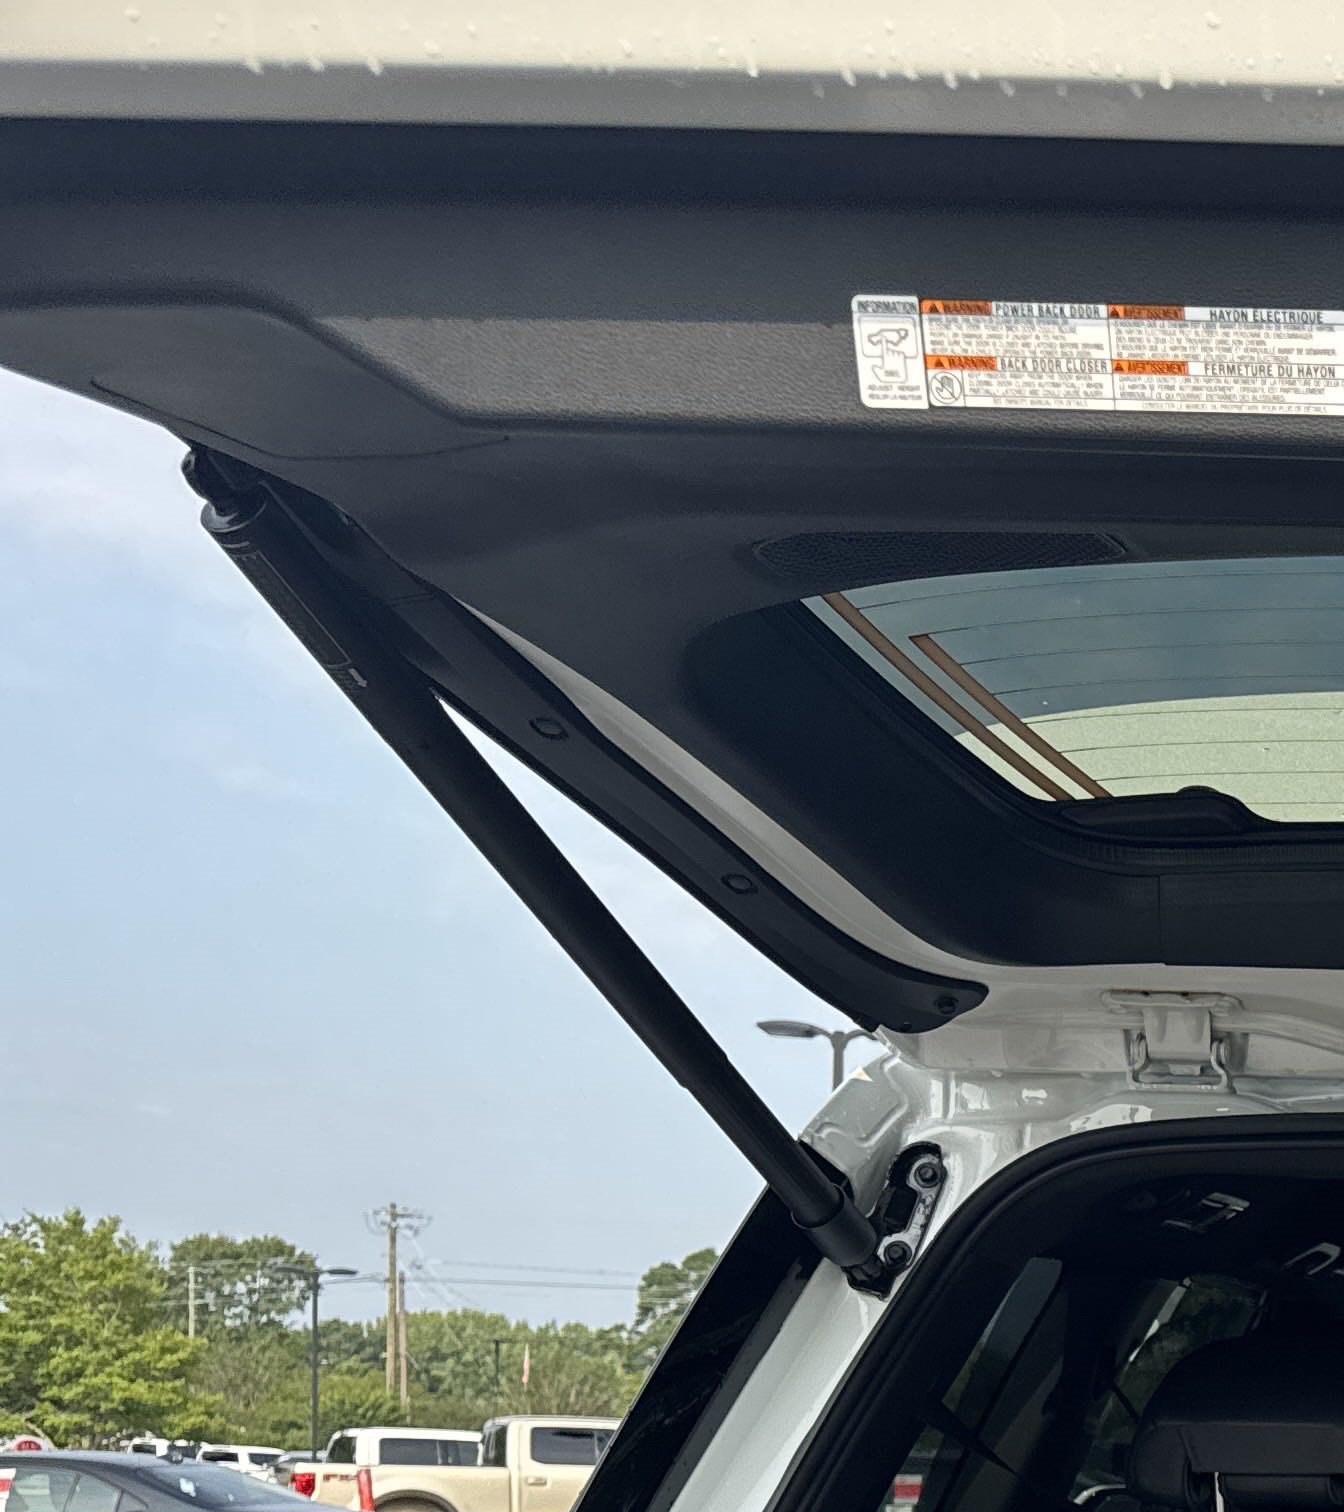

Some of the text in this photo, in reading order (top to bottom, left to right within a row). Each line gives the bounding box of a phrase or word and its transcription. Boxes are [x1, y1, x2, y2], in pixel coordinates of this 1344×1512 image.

[995, 303, 1101, 319] POWER BACK DOOR
[1209, 309, 1248, 322] HAYON
[1001, 357, 1107, 373] BACK DOOR CLOSER
[1204, 363, 1336, 379] FERMETURE DU HAYON
